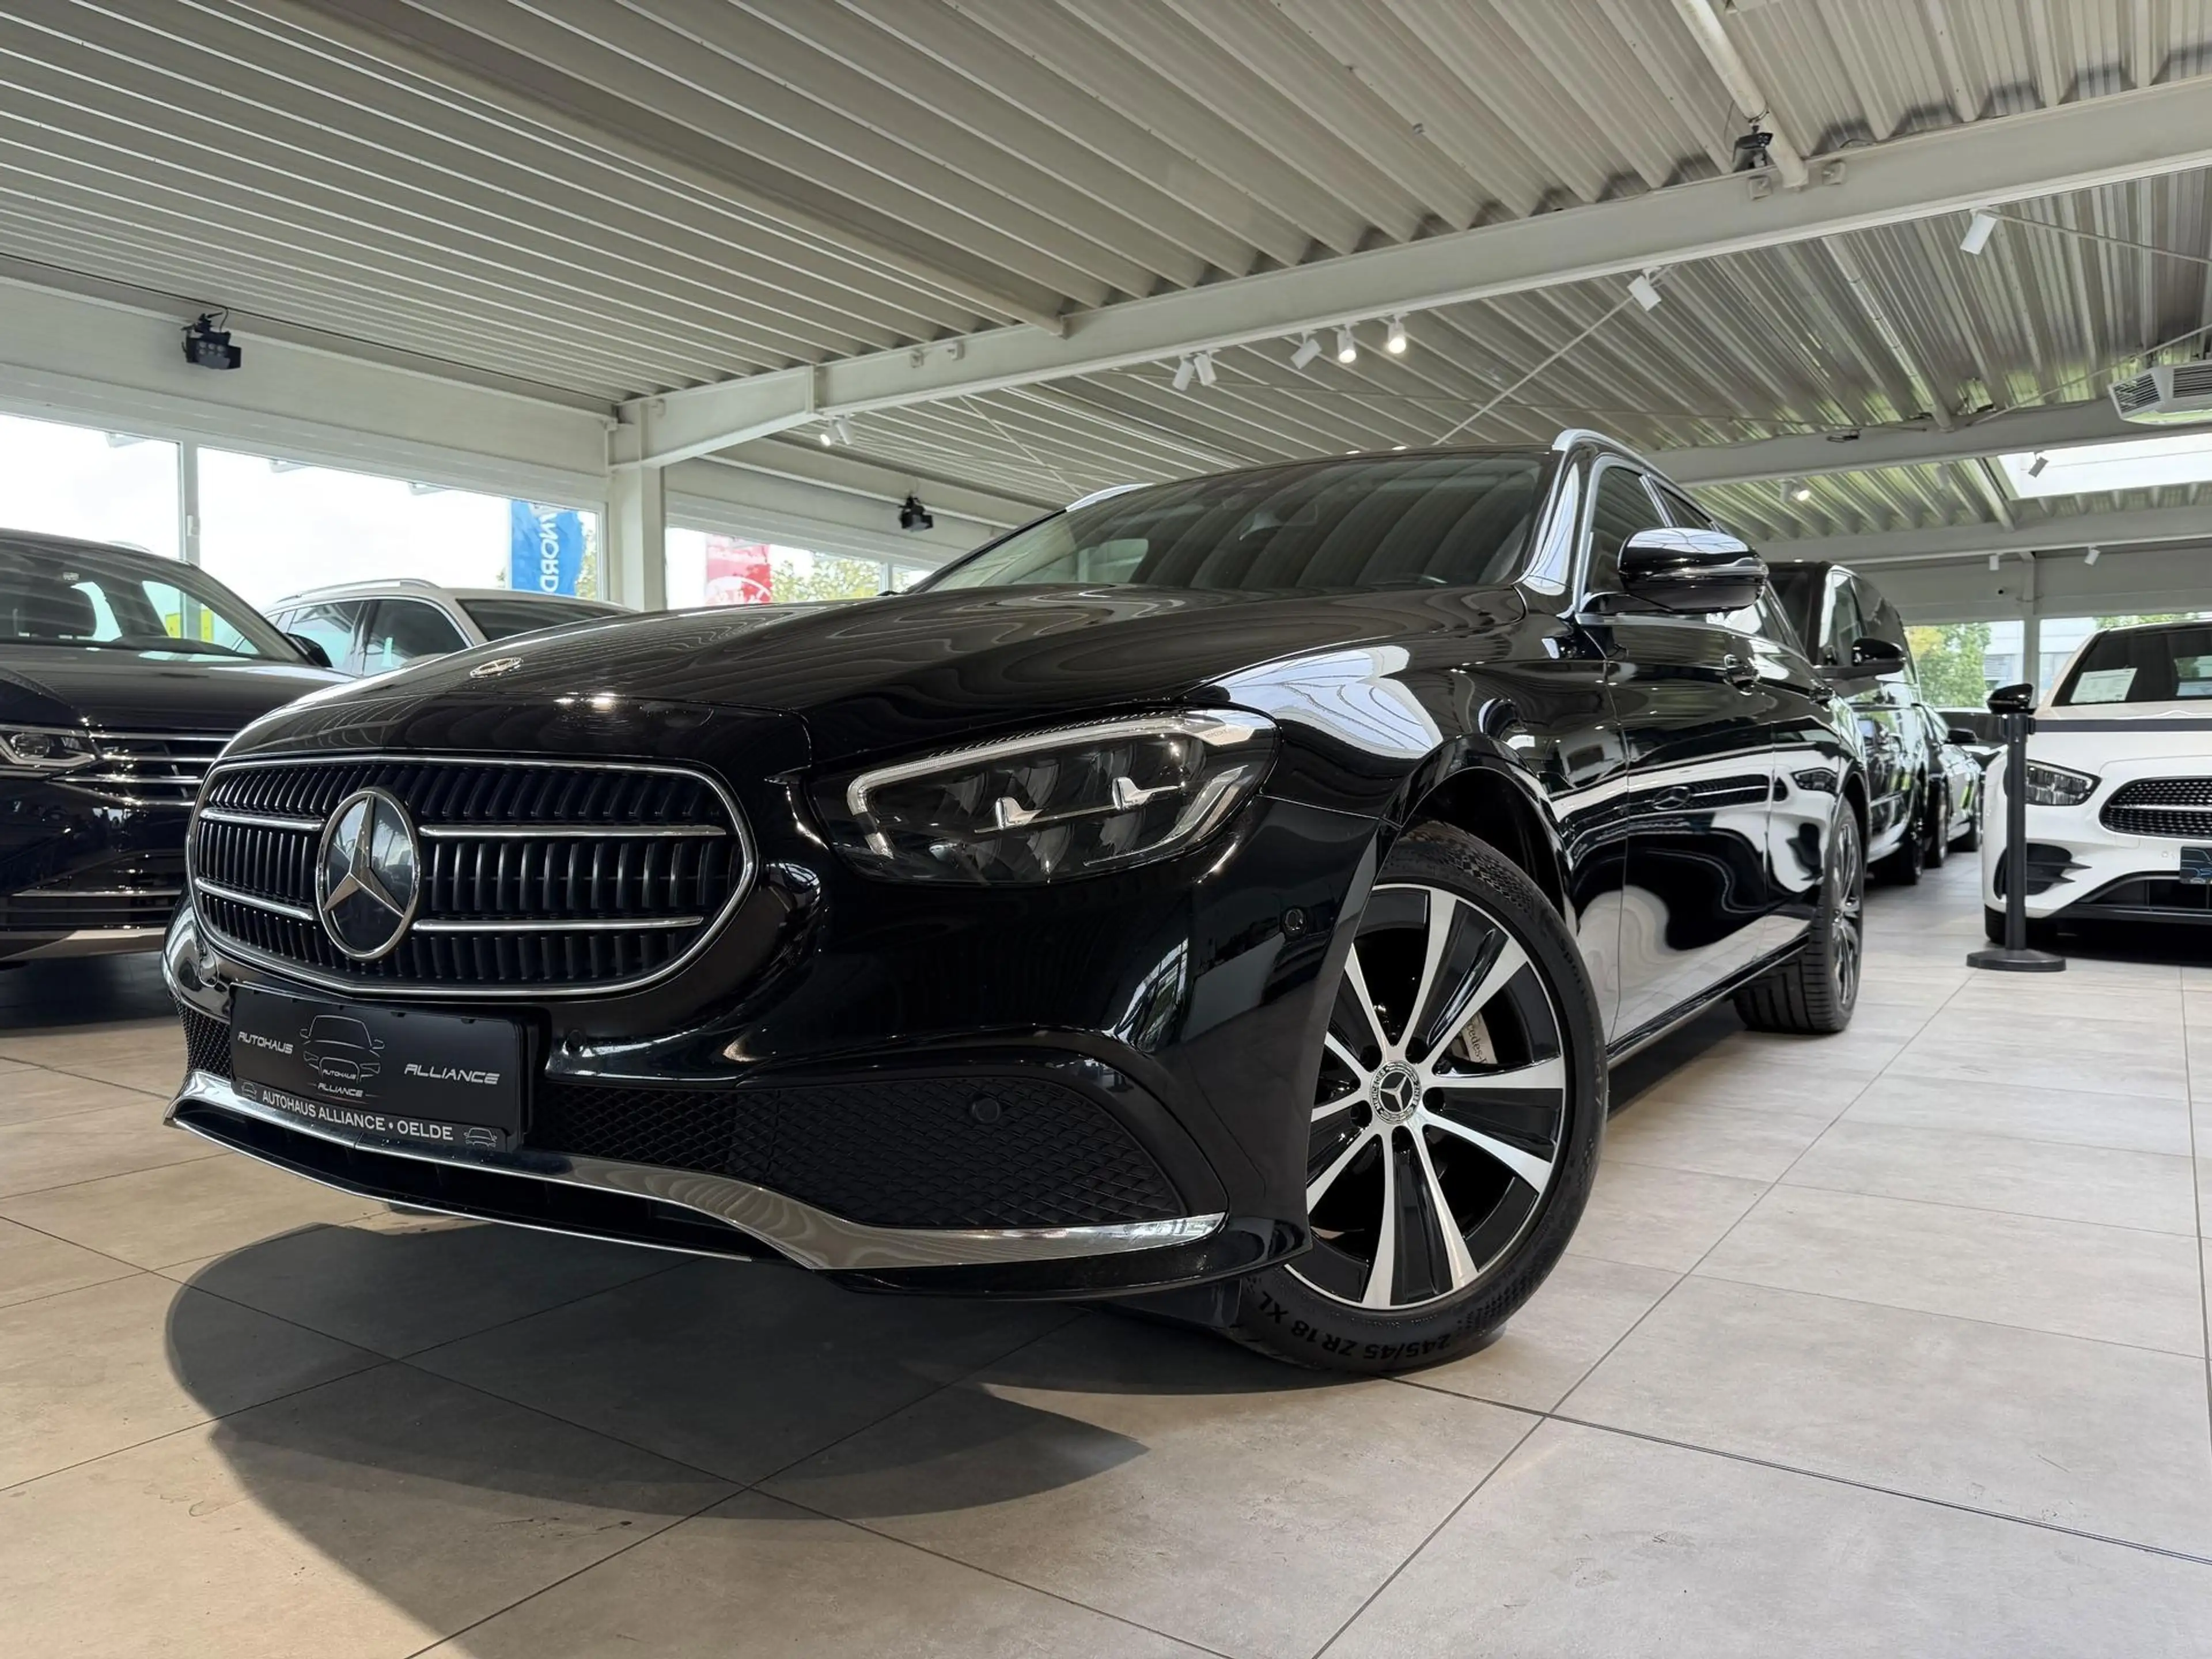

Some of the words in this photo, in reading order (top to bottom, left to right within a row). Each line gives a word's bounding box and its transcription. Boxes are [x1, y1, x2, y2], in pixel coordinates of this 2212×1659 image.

[237, 1031, 294, 1055] AUTOHAUS
[404, 1063, 500, 1085] ALLIANCE
[323, 1069, 357, 1080] AUTOHAUS
[317, 1082, 363, 1097] ALLIANCE
[262, 1090, 316, 1118] AUTOHAUS
[318, 1107, 386, 1131] ALLIANCE
[397, 1120, 454, 1141] OELDE
[1259, 1290, 1289, 1324] XL
[1291, 1320, 1318, 1343] 18
[1363, 1333, 1451, 1359] 245/45
